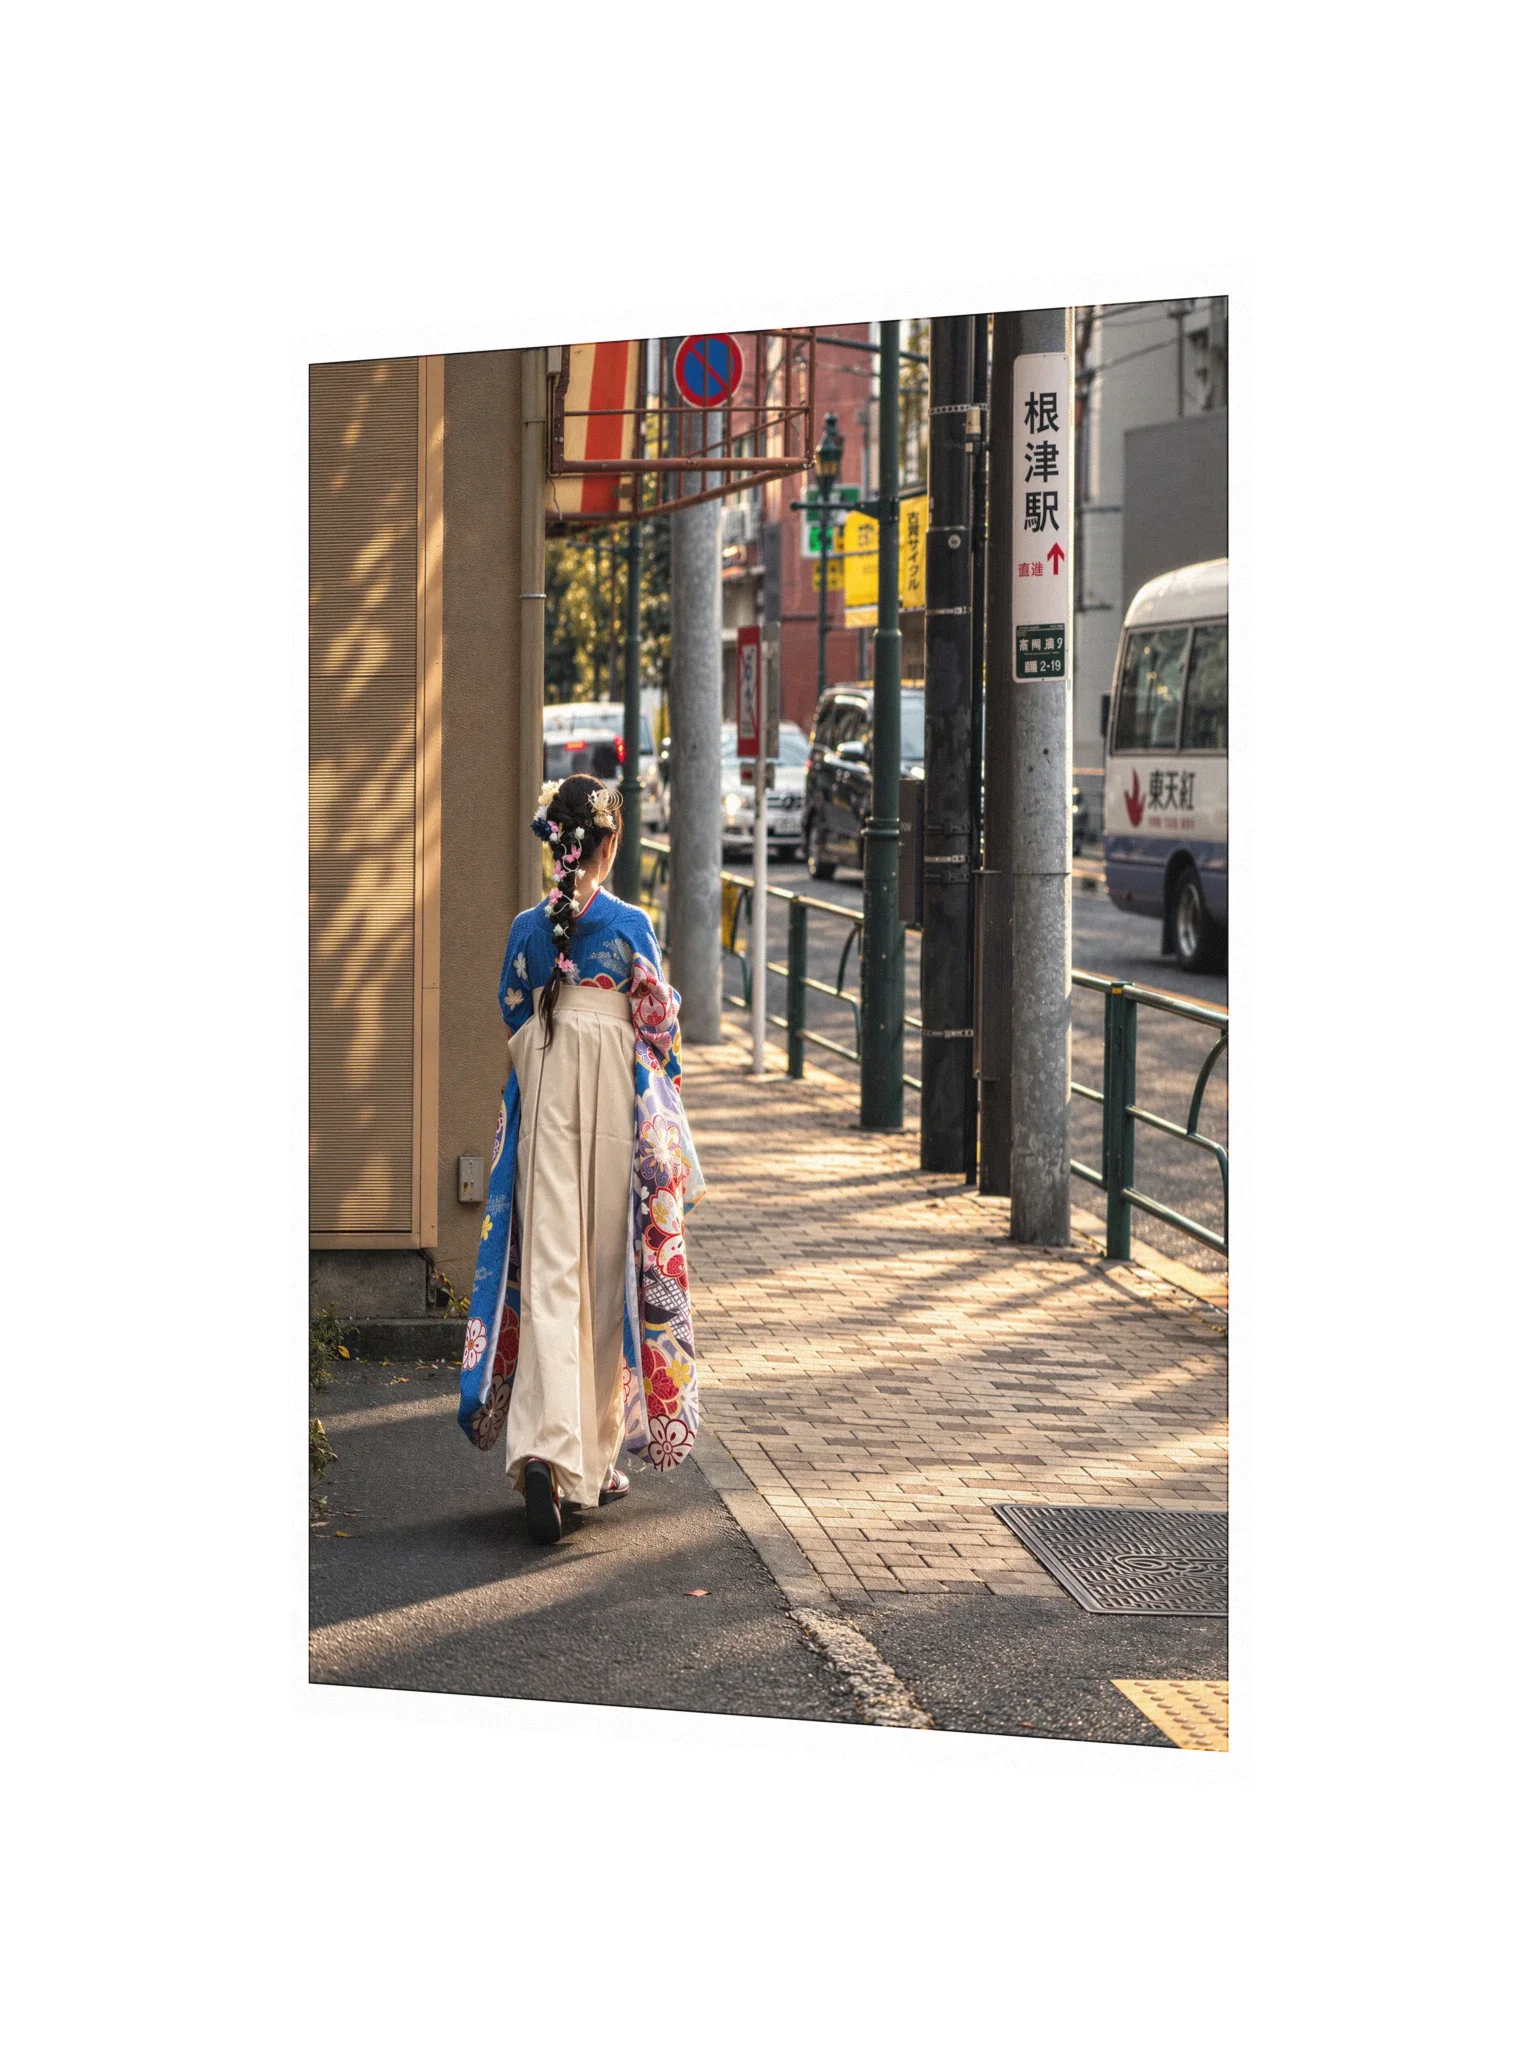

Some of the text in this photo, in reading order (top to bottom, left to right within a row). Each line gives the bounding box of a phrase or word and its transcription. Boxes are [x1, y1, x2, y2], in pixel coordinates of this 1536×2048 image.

[1024, 391, 1060, 533] 根津駅
[1018, 562, 1044, 578] 直進
[1148, 769, 1196, 812] 東天紅
